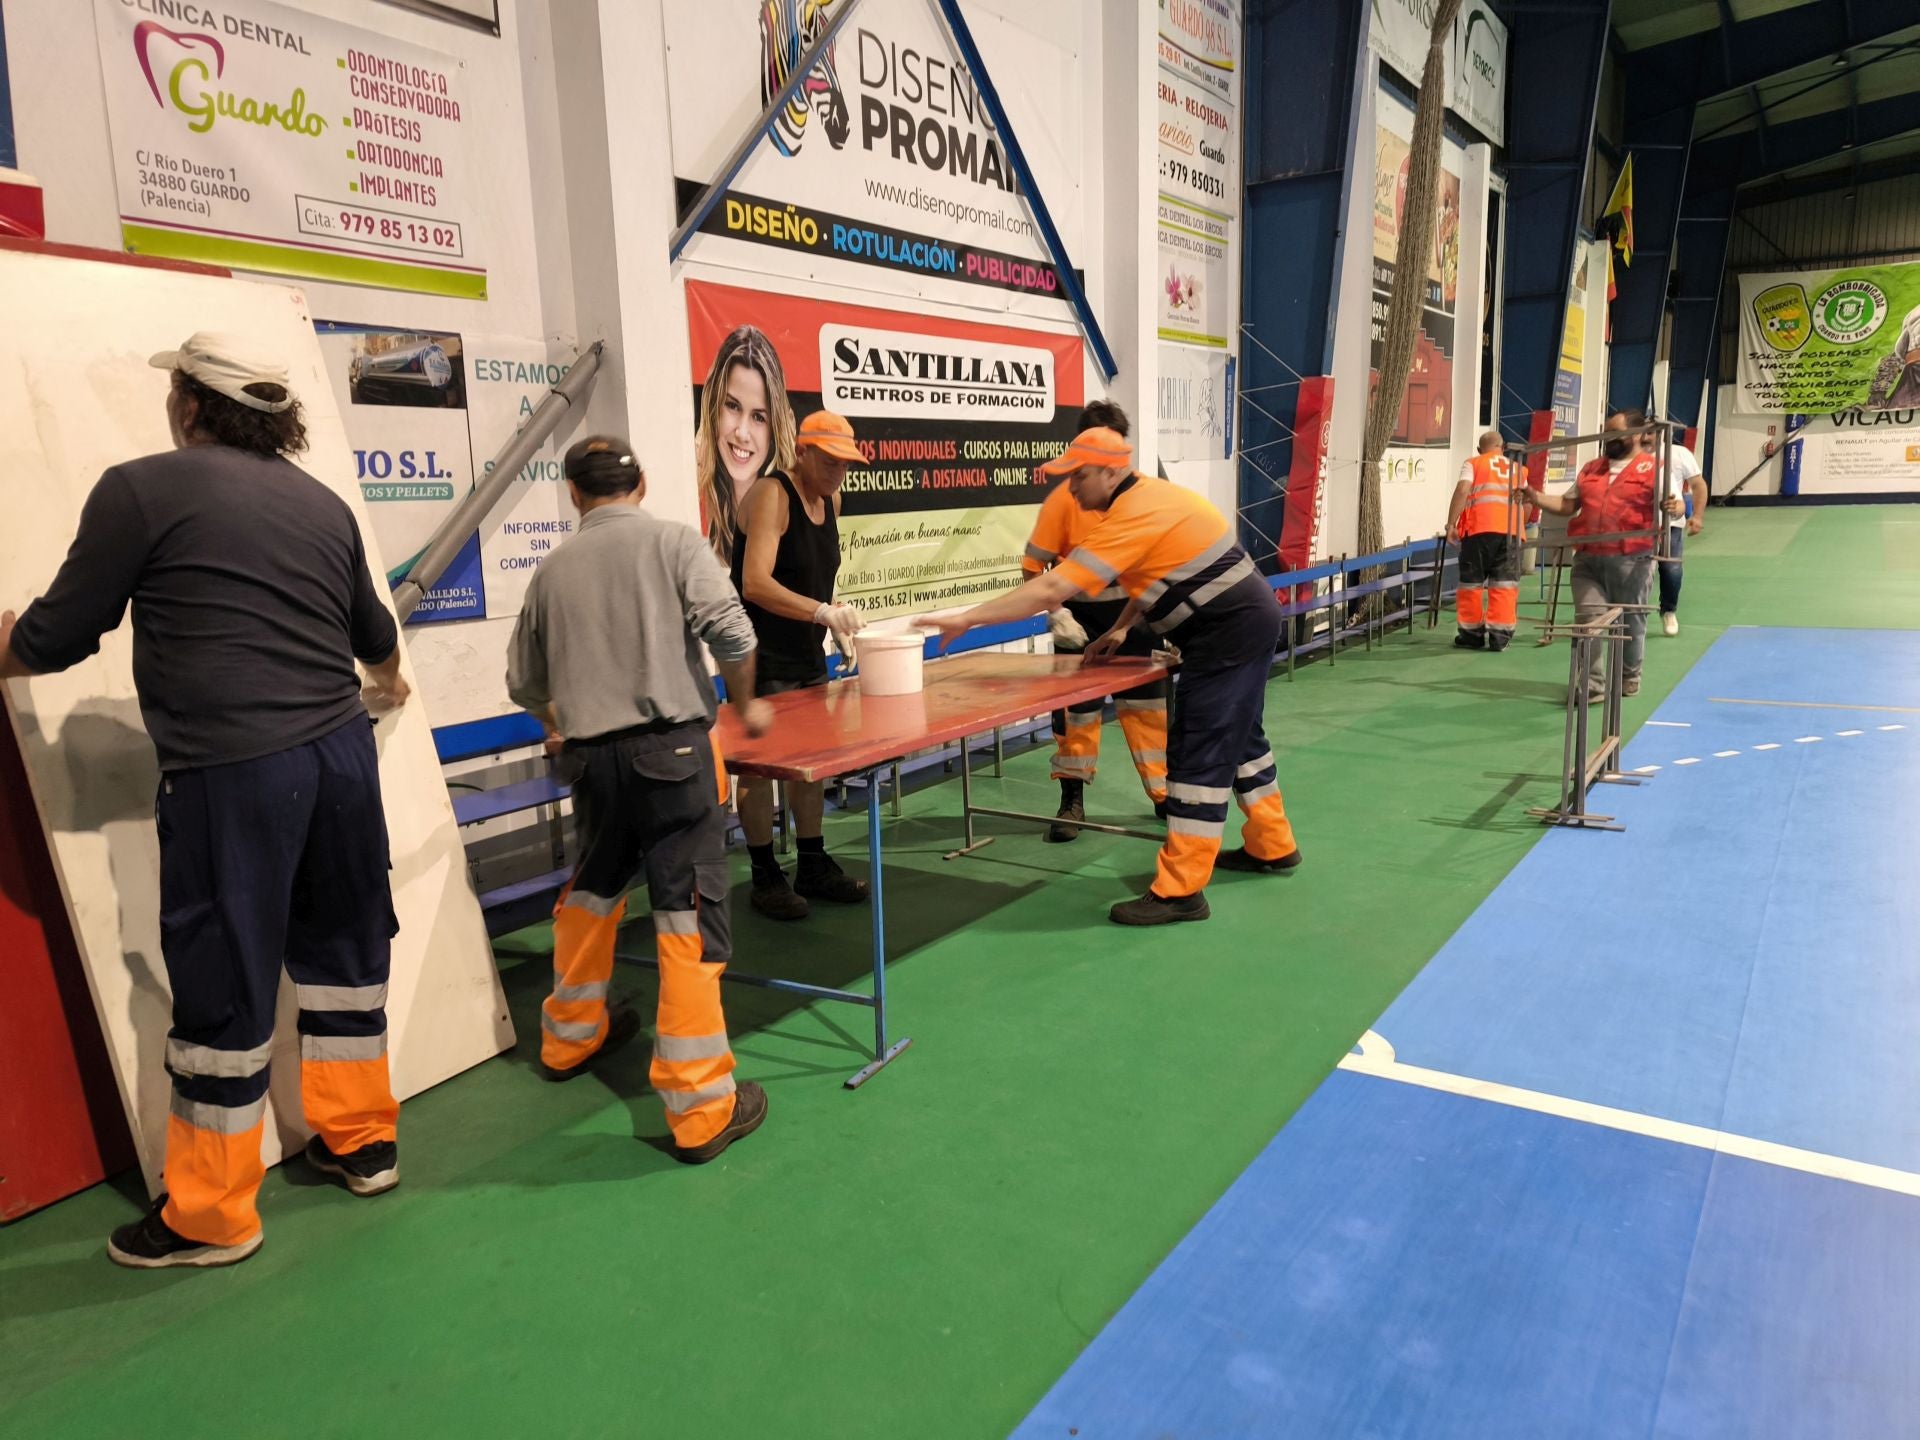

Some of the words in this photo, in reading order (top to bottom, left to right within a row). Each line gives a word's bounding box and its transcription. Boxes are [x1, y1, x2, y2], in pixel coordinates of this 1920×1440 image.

[223, 15, 311, 56] DENTAL
[168, 58, 328, 137] Guardo
[350, 75, 460, 122] CONSERVADORA
[1185, 96, 1229, 132] RELOJERIA
[136, 150, 150, 167] C/
[154, 153, 178, 171] Río
[182, 158, 224, 180] Duero
[229, 168, 236, 182] 1
[357, 140, 443, 178] ORTODONCIA
[1200, 140, 1225, 165] Guardo
[138, 170, 186, 192] 34880
[190, 179, 250, 203] GUARDO
[360, 172, 436, 207] IMPLANTES
[1170, 160, 1188, 184] 979
[1192, 169, 1225, 198] 850331
[141, 189, 211, 217] (Palencia)
[865, 178, 1033, 237] www.disenopromail.com
[304, 208, 336, 229] Cita:
[339, 212, 375, 235] 979
[380, 219, 402, 240] 85
[407, 224, 428, 244] 13
[433, 228, 455, 248] 02
[1169, 209, 1192, 226] DENTAL
[1193, 217, 1203, 230] LOS
[1205, 221, 1223, 236] ARCOS
[726, 199, 818, 245] DISEÑO
[832, 223, 955, 273] ROTULACIÓN
[966, 253, 1057, 291] PUBLICIDAD
[1169, 234, 1192, 250] DENTAL
[1193, 240, 1203, 253] LOS
[1205, 245, 1223, 259] ARCOS
[833, 337, 1046, 388] SANTILLANA
[1748, 352, 1794, 360] SOLOS
[1798, 348, 1873, 359] PODEMOS
[1759, 361, 1804, 369] HACER
[1811, 360, 1854, 369] POCO,
[836, 386, 924, 403] CENTROS
[931, 391, 951, 404] DE
[957, 394, 1045, 409] FORMACIÓN
[1744, 379, 1871, 389] CONSEGUIREMOS
[1754, 391, 1790, 399] TODO
[1824, 390, 1855, 398] QUE
[1762, 400, 1847, 408] QUERAMOS
[879, 440, 956, 461] INDIVIDUALES
[963, 440, 1001, 459] CURSOS
[1003, 441, 1030, 459] PARA
[399, 450, 453, 479] S.L.
[386, 487, 394, 497] Y
[398, 486, 449, 498] PELLETS
[922, 469, 931, 489] A
[933, 468, 988, 489] DISTANCIA
[993, 468, 1027, 486] ONLINE
[504, 521, 572, 535] INFORMESE
[850, 528, 901, 560] formación
[904, 530, 915, 541] en
[918, 522, 950, 537] buenas
[952, 524, 982, 536] manos
[531, 539, 550, 550] SIN
[860, 570, 875, 584] Ebro
[877, 570, 882, 582] 3
[887, 566, 914, 581] GUARDO
[917, 562, 946, 580] (Palencia)
[436, 597, 477, 611] (Palencia)
[461, 587, 476, 597] S.L.
